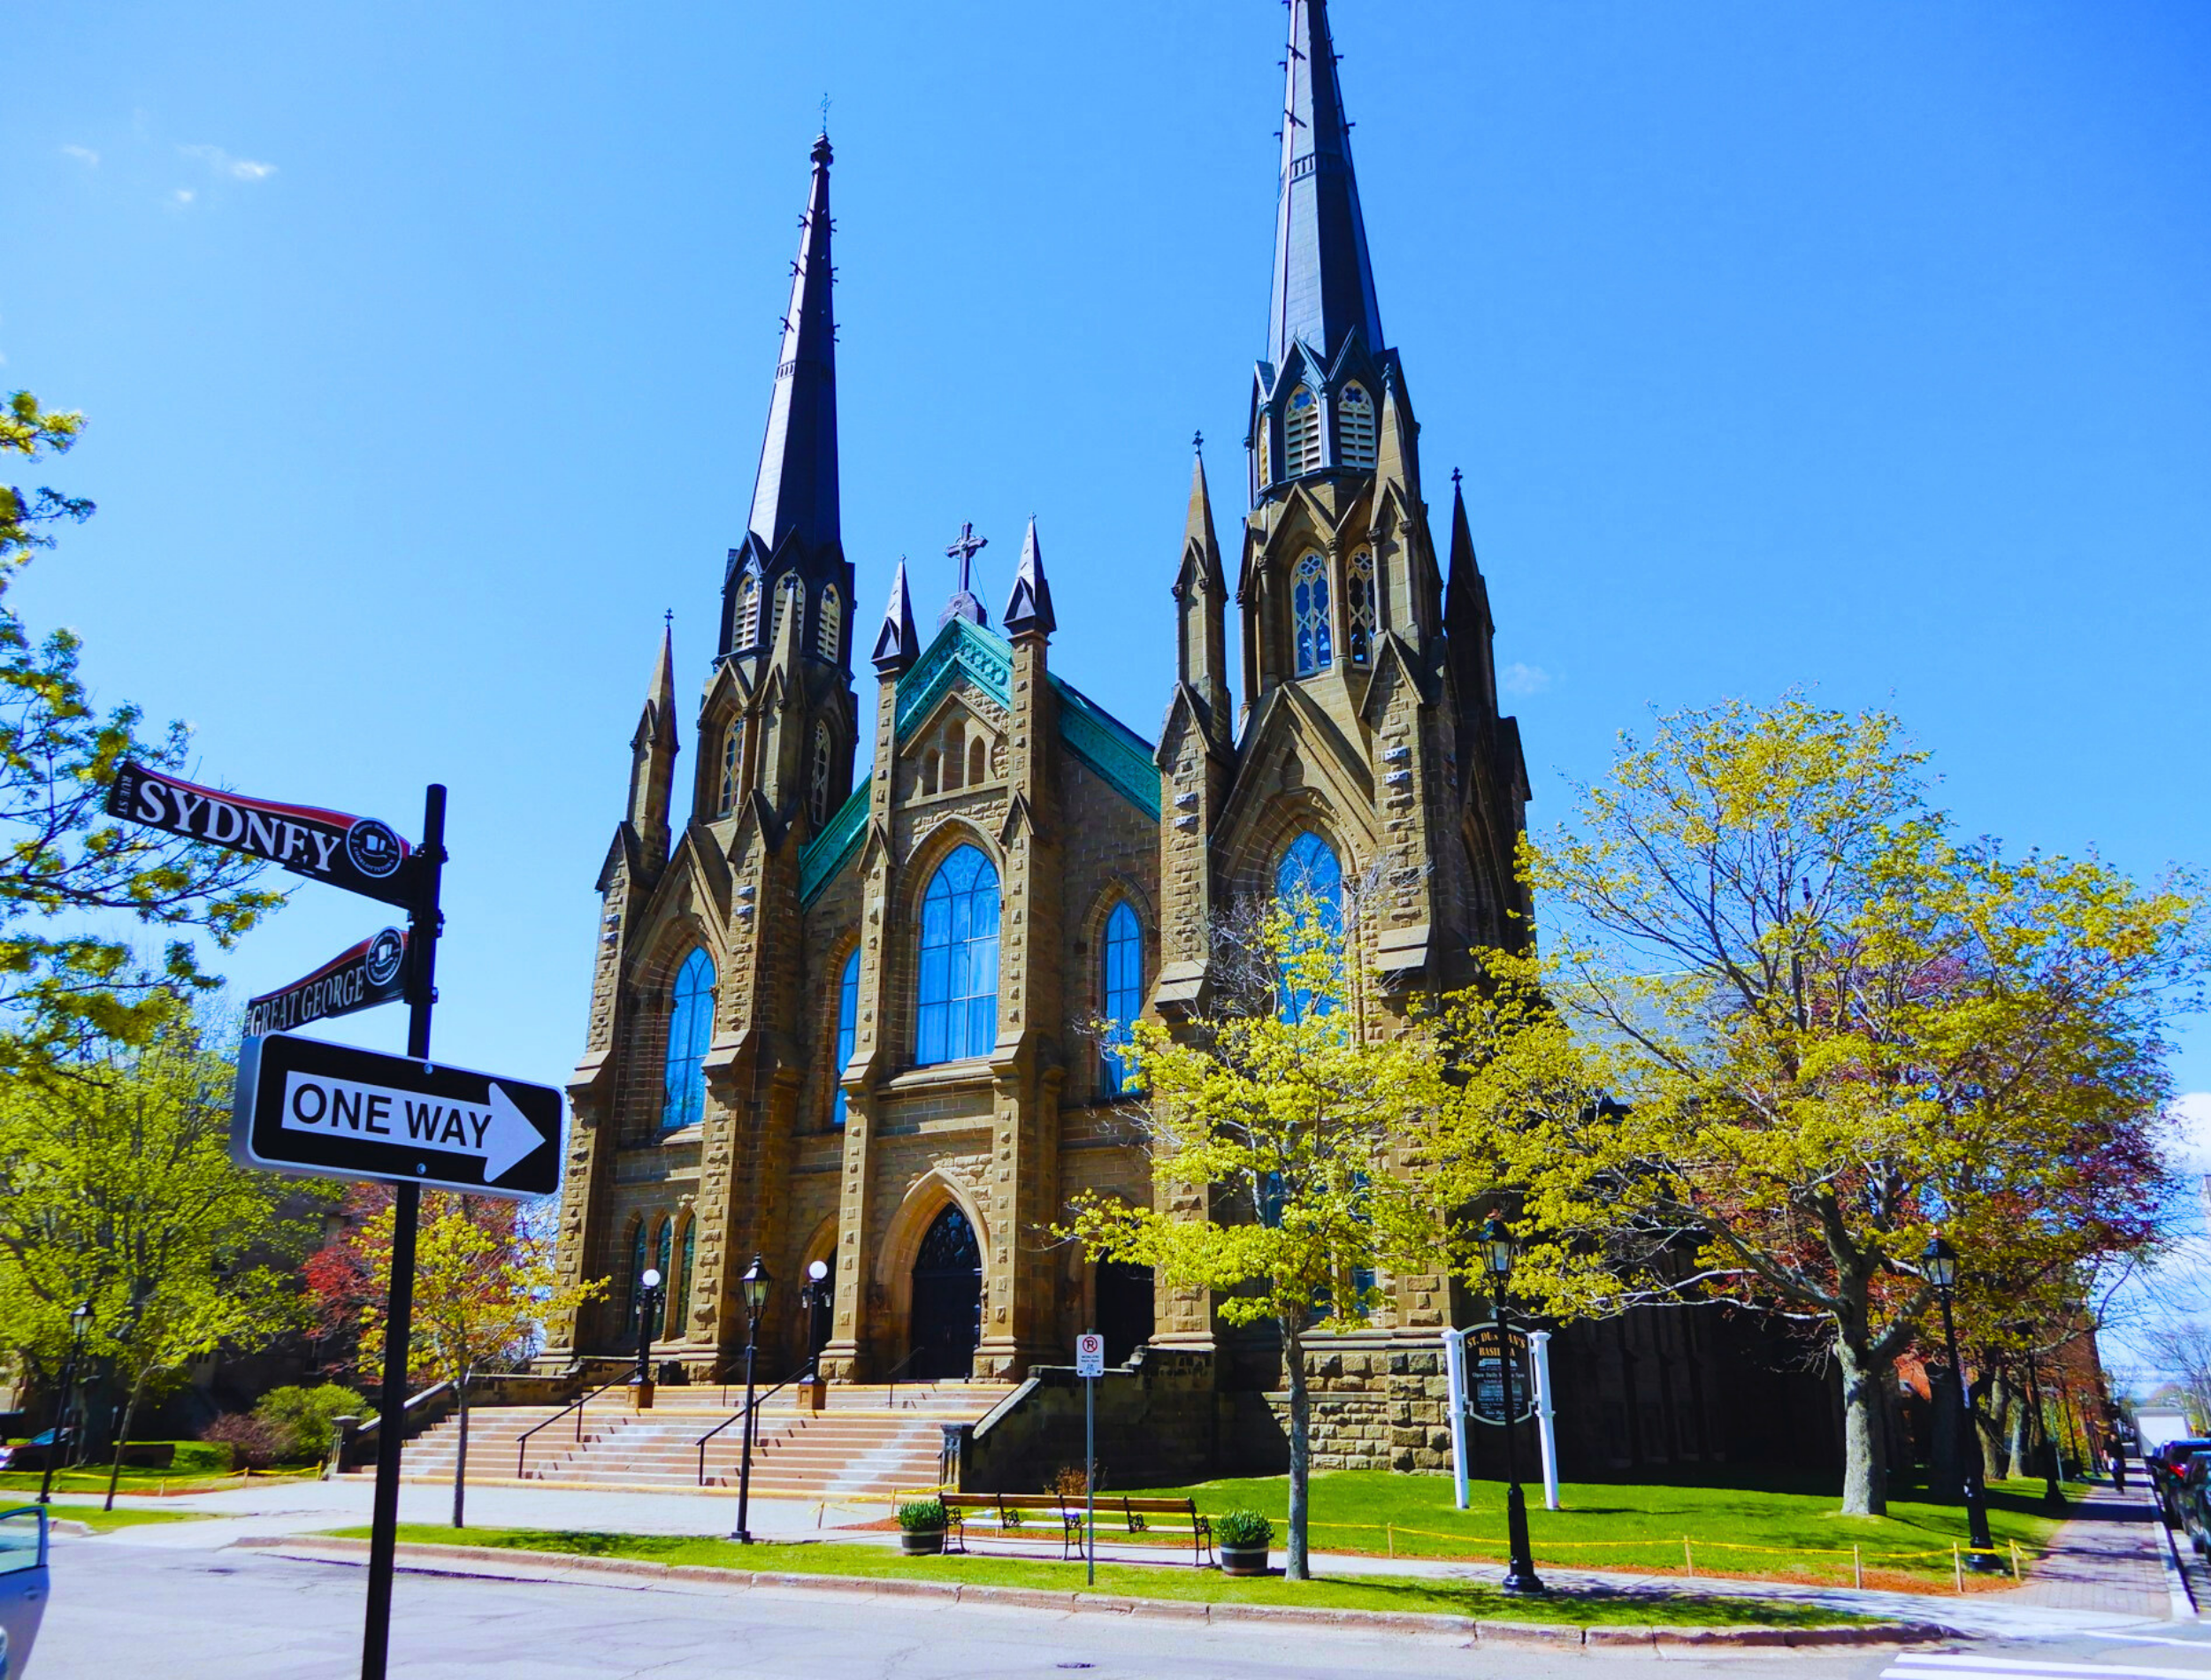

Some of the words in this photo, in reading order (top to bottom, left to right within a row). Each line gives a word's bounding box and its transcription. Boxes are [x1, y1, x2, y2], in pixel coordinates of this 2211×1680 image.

[136, 780, 341, 873] SYDNEY
[250, 990, 300, 1036] GREAT
[302, 966, 364, 1021] GEORGE
[293, 1083, 392, 1135] ONE
[404, 1099, 493, 1149] WAY
[1467, 1336, 1480, 1348] ST.
[1480, 1331, 1526, 1348] DUAN'S
[1479, 1347, 1516, 1356] BASILA
